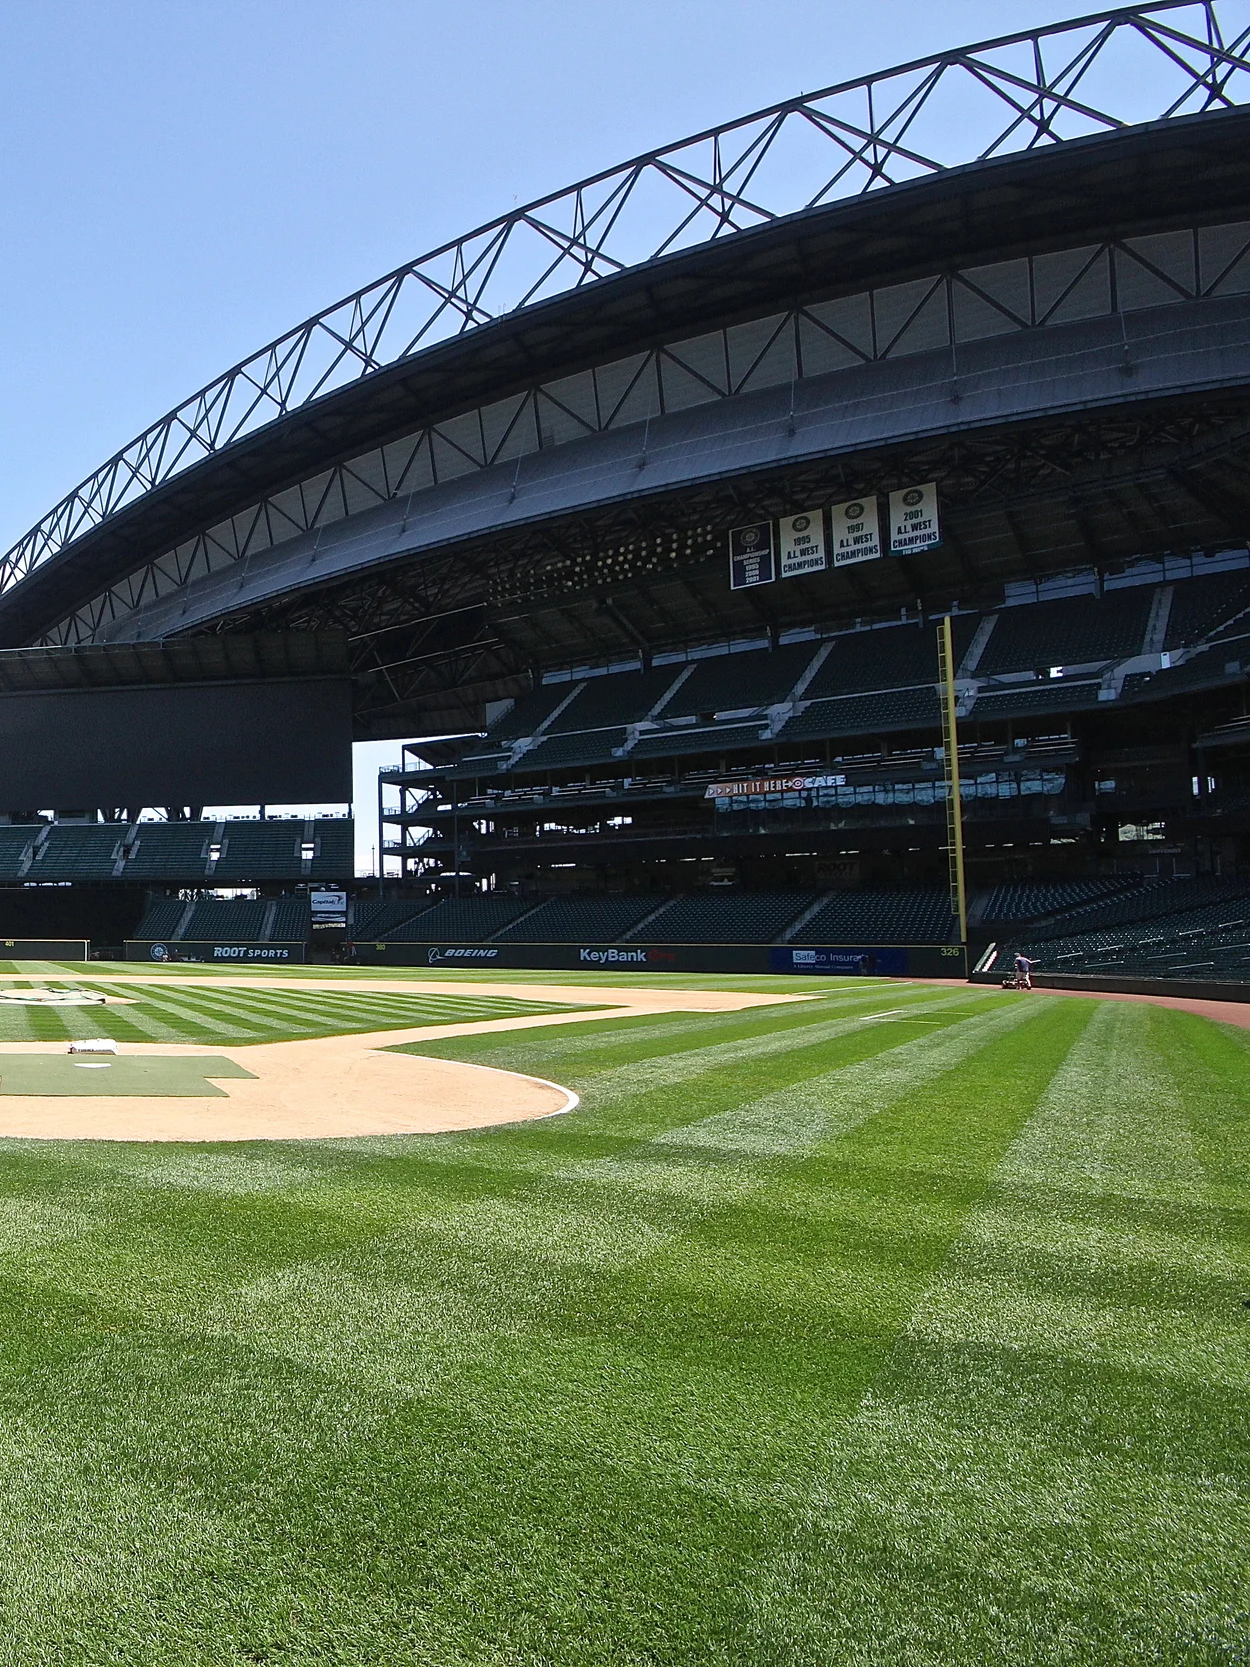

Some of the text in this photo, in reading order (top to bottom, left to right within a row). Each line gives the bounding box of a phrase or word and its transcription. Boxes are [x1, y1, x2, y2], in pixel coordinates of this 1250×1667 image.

[904, 509, 923, 521] 2001
[847, 522, 864, 534] 1997
[897, 520, 932, 535] A.L. WEST
[794, 535, 810, 546] 1995
[852, 533, 873, 546] WEST
[892, 532, 937, 548] CHAMPIONS
[800, 545, 819, 558] WEST
[836, 544, 878, 562] CHAMPIONS
[783, 556, 824, 573] CHAMPIONS
[733, 775, 846, 794] HIT IT HERE CAFE
[214, 947, 288, 958] ROOT SPORTS
[444, 949, 498, 958] BOEING
[580, 948, 646, 964] KeyBank
[795, 952, 826, 962] Safeco
[941, 948, 960, 956] 326
